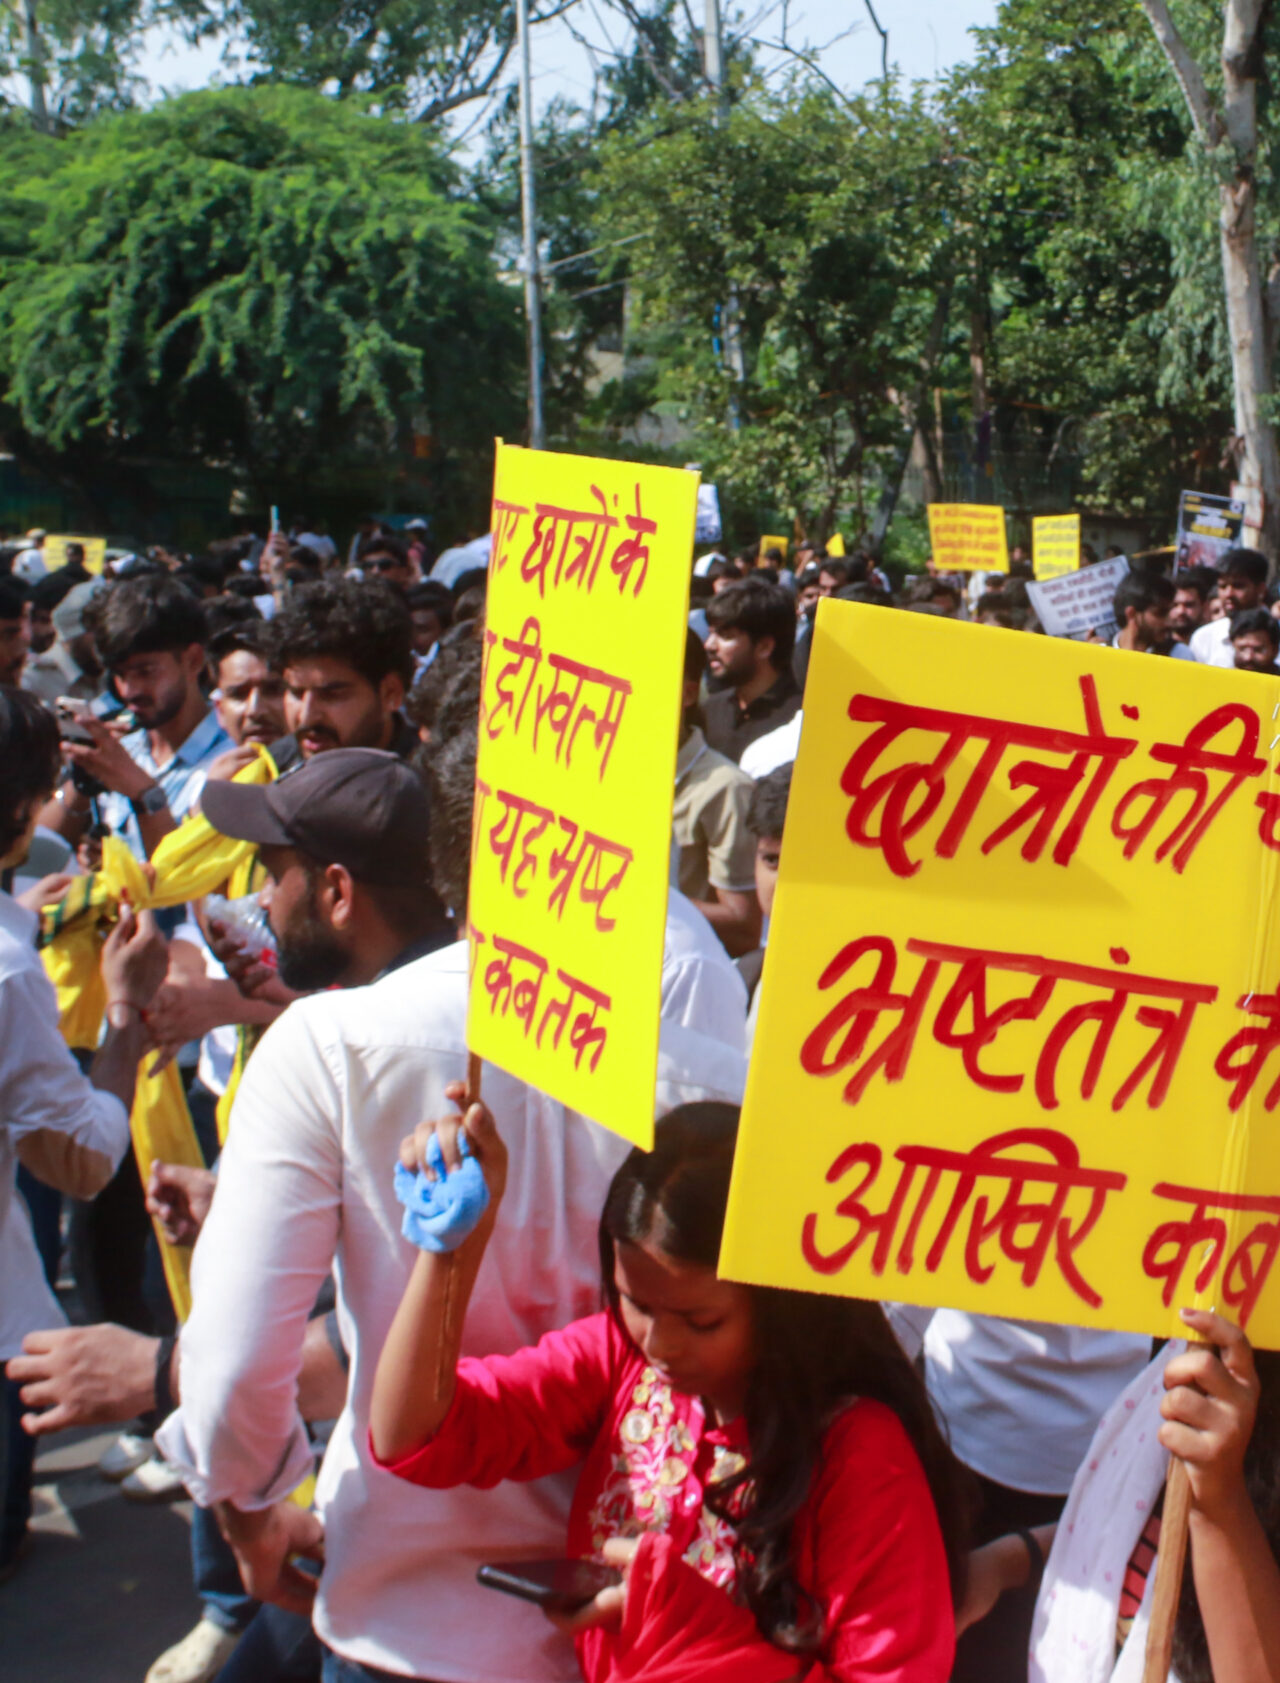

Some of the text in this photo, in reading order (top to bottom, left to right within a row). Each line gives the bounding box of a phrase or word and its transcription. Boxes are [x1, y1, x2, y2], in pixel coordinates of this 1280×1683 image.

[521, 484, 619, 600] छात्रों
[611, 482, 657, 598] के
[488, 616, 542, 741] ही
[533, 653, 633, 784] खत्म
[840, 674, 1139, 879] छात्रों
[1111, 703, 1268, 874] की
[490, 789, 556, 898] यह
[548, 815, 634, 932] भ्रष्ट
[484, 934, 549, 1039] कब
[536, 968, 611, 1074] तक
[800, 936, 1219, 1112] भ्रष्टतंत्र
[801, 1128, 1128, 1309] आखिर
